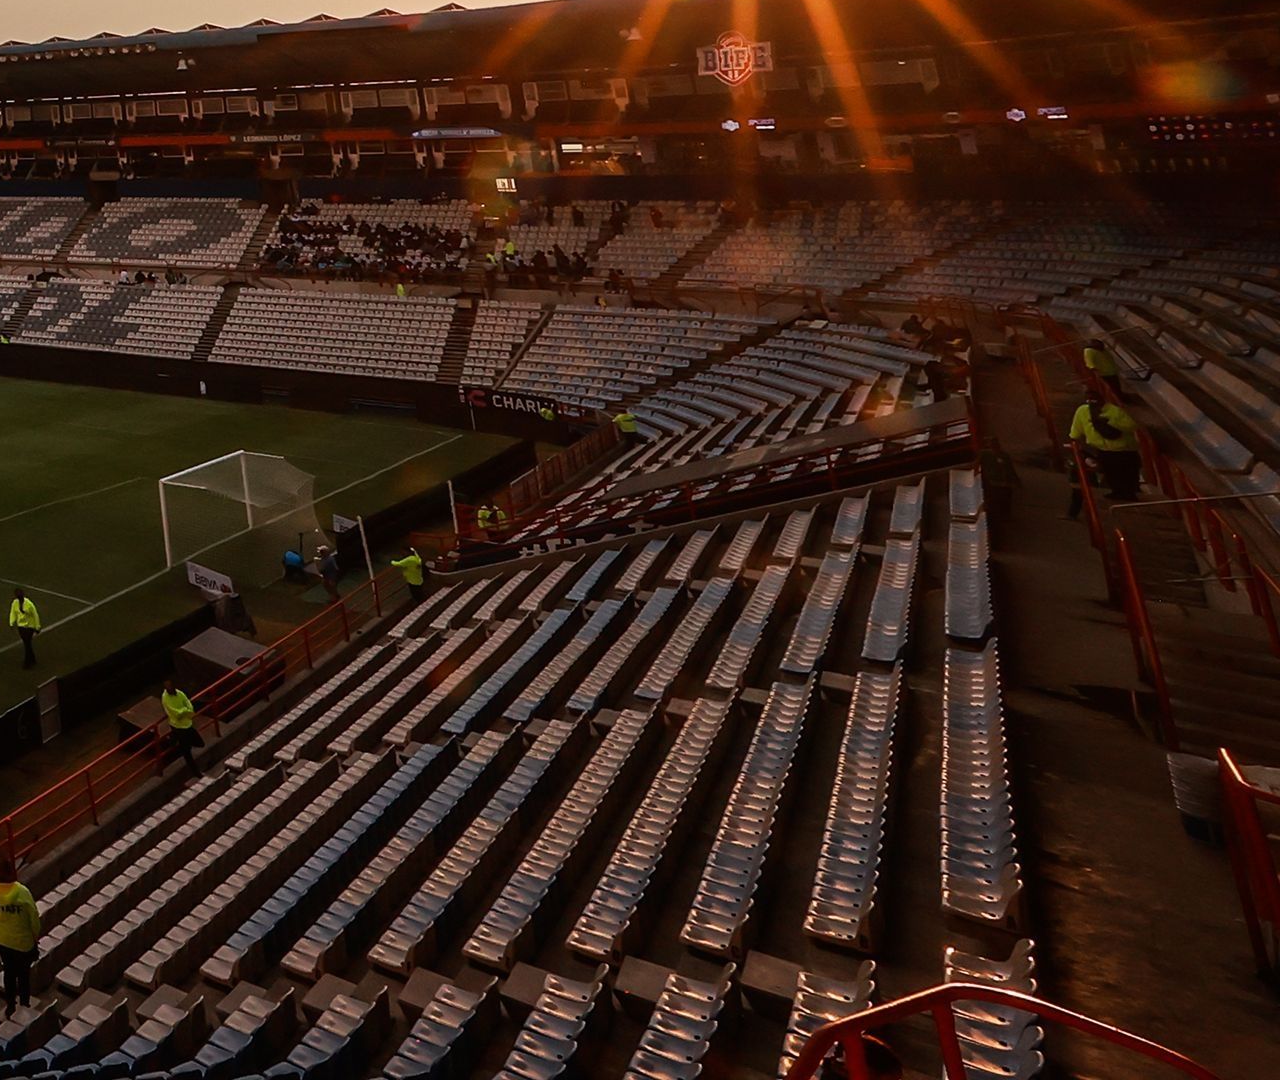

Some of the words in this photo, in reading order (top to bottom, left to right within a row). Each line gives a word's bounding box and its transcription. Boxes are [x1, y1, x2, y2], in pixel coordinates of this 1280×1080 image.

[703, 46, 767, 72] BIFE
[492, 395, 554, 416] CHARLY
[194, 573, 220, 591] BBVA
